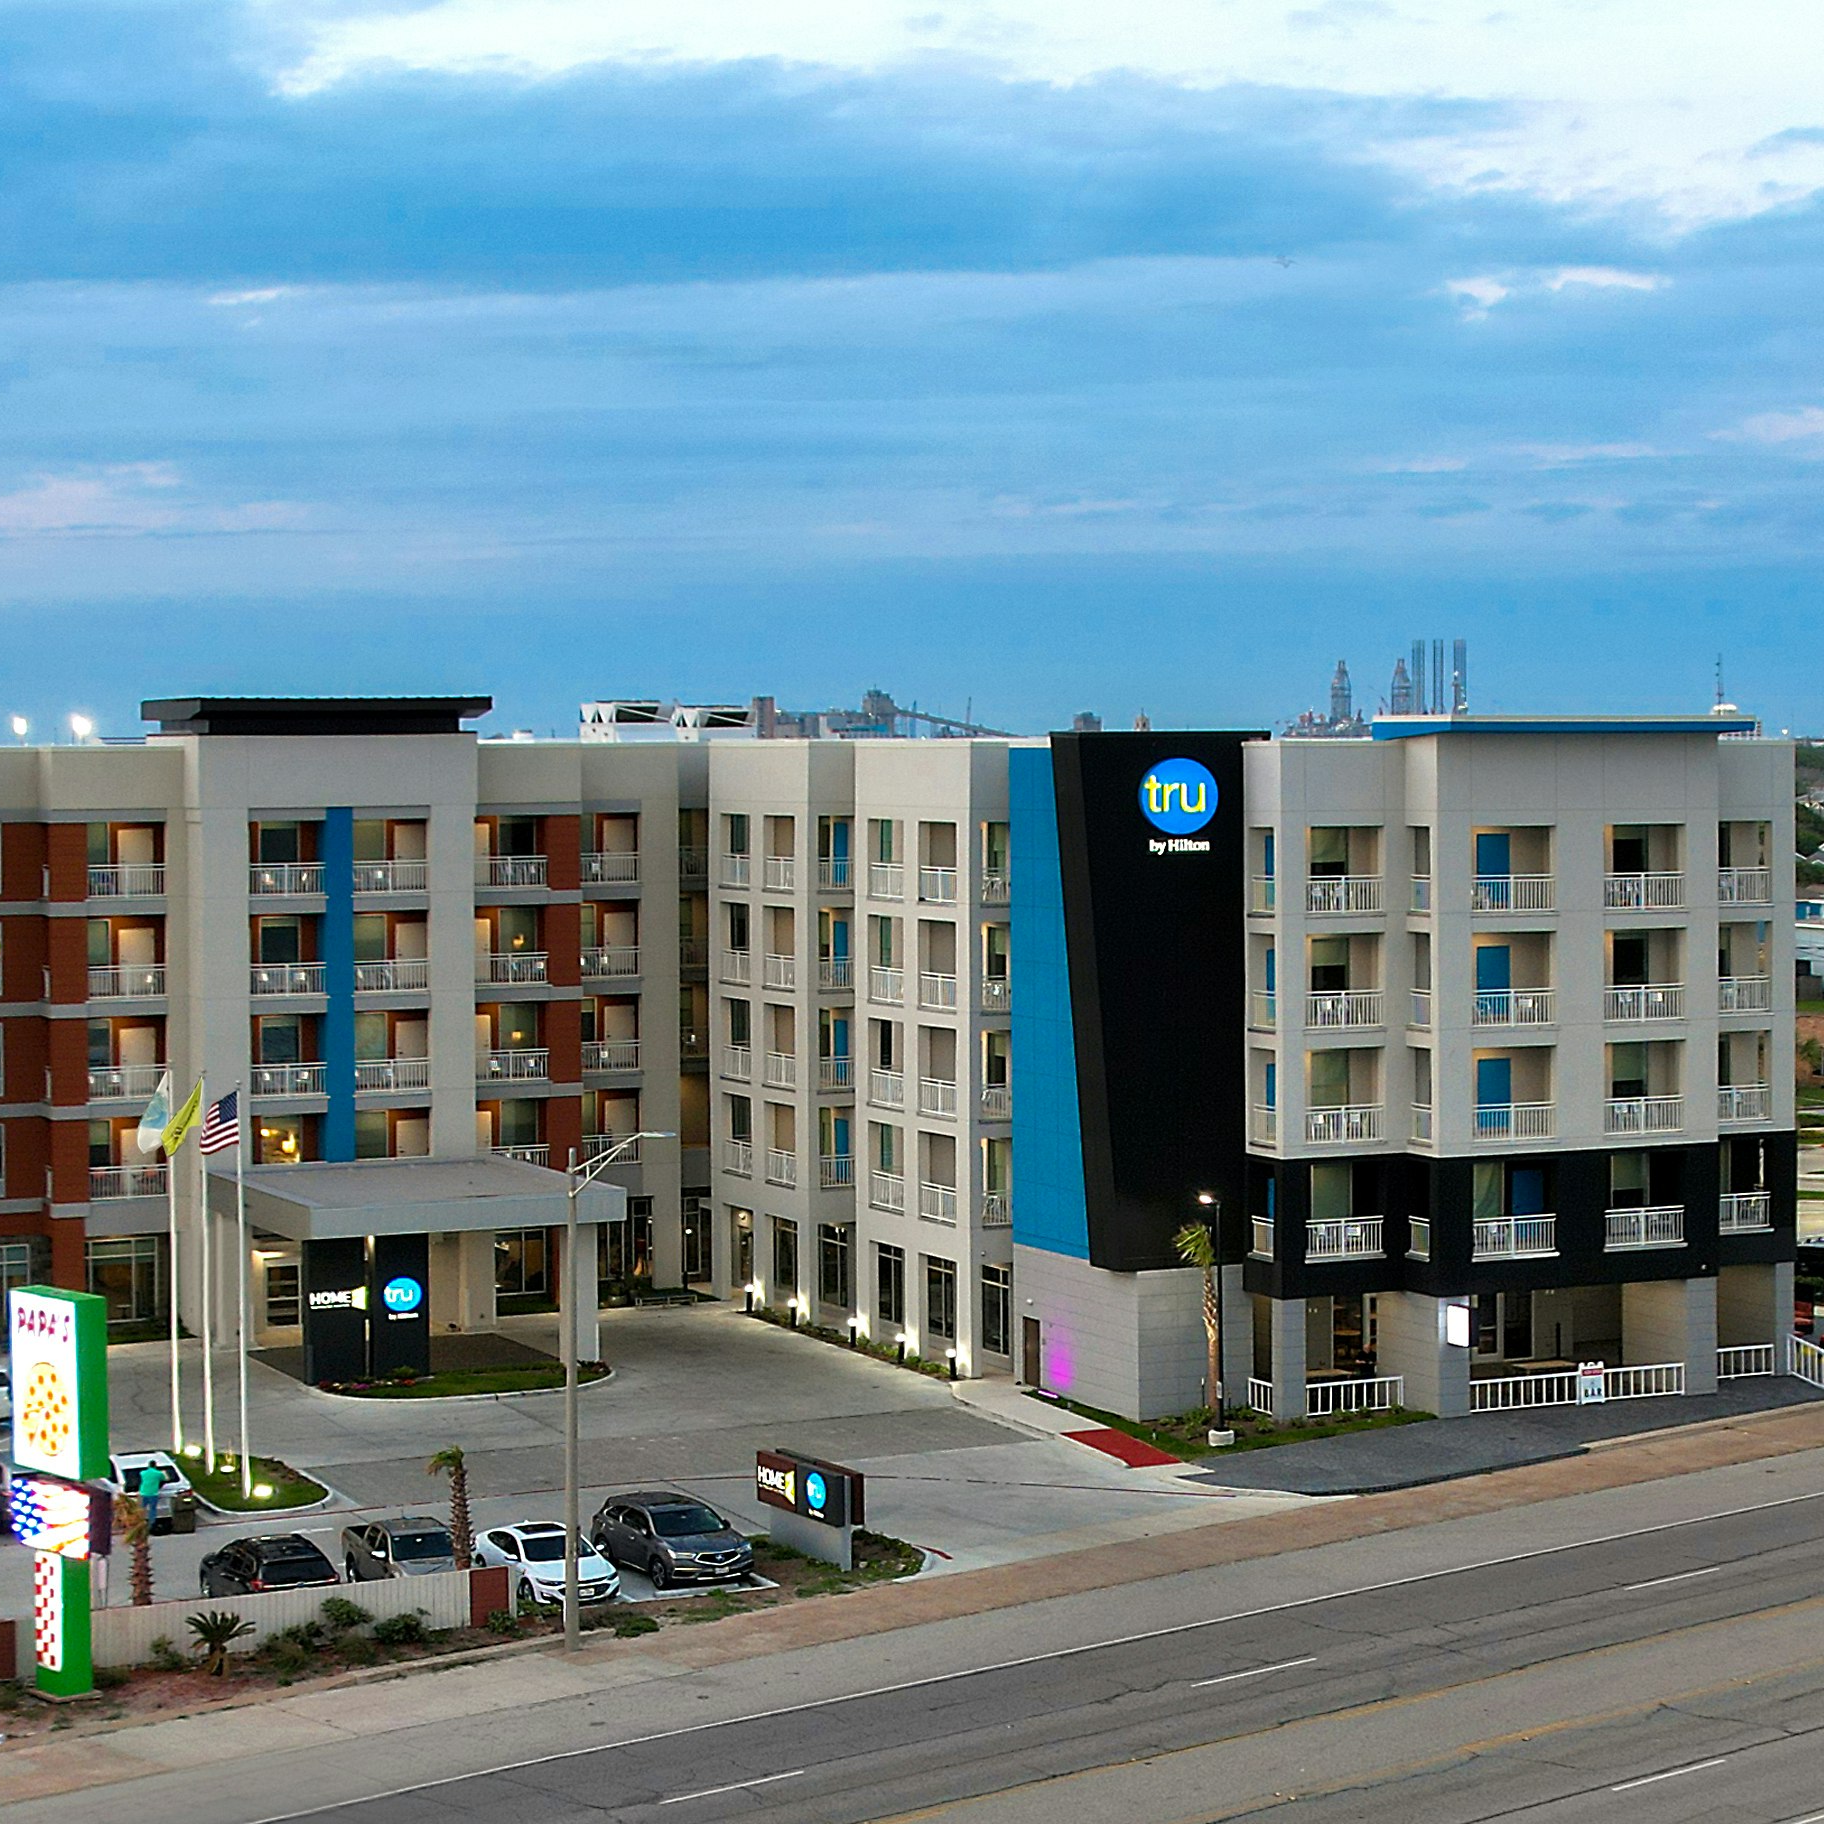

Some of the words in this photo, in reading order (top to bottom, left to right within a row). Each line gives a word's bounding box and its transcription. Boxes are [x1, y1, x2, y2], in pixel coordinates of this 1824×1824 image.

[1144, 774, 1207, 813] tru
[1149, 838, 1167, 855] by
[1168, 838, 1211, 852] Hilton
[309, 1290, 352, 1306] HOME
[384, 1286, 414, 1303] tru
[17, 1306, 71, 1343] PAPA'S
[757, 1465, 786, 1490] HOME
